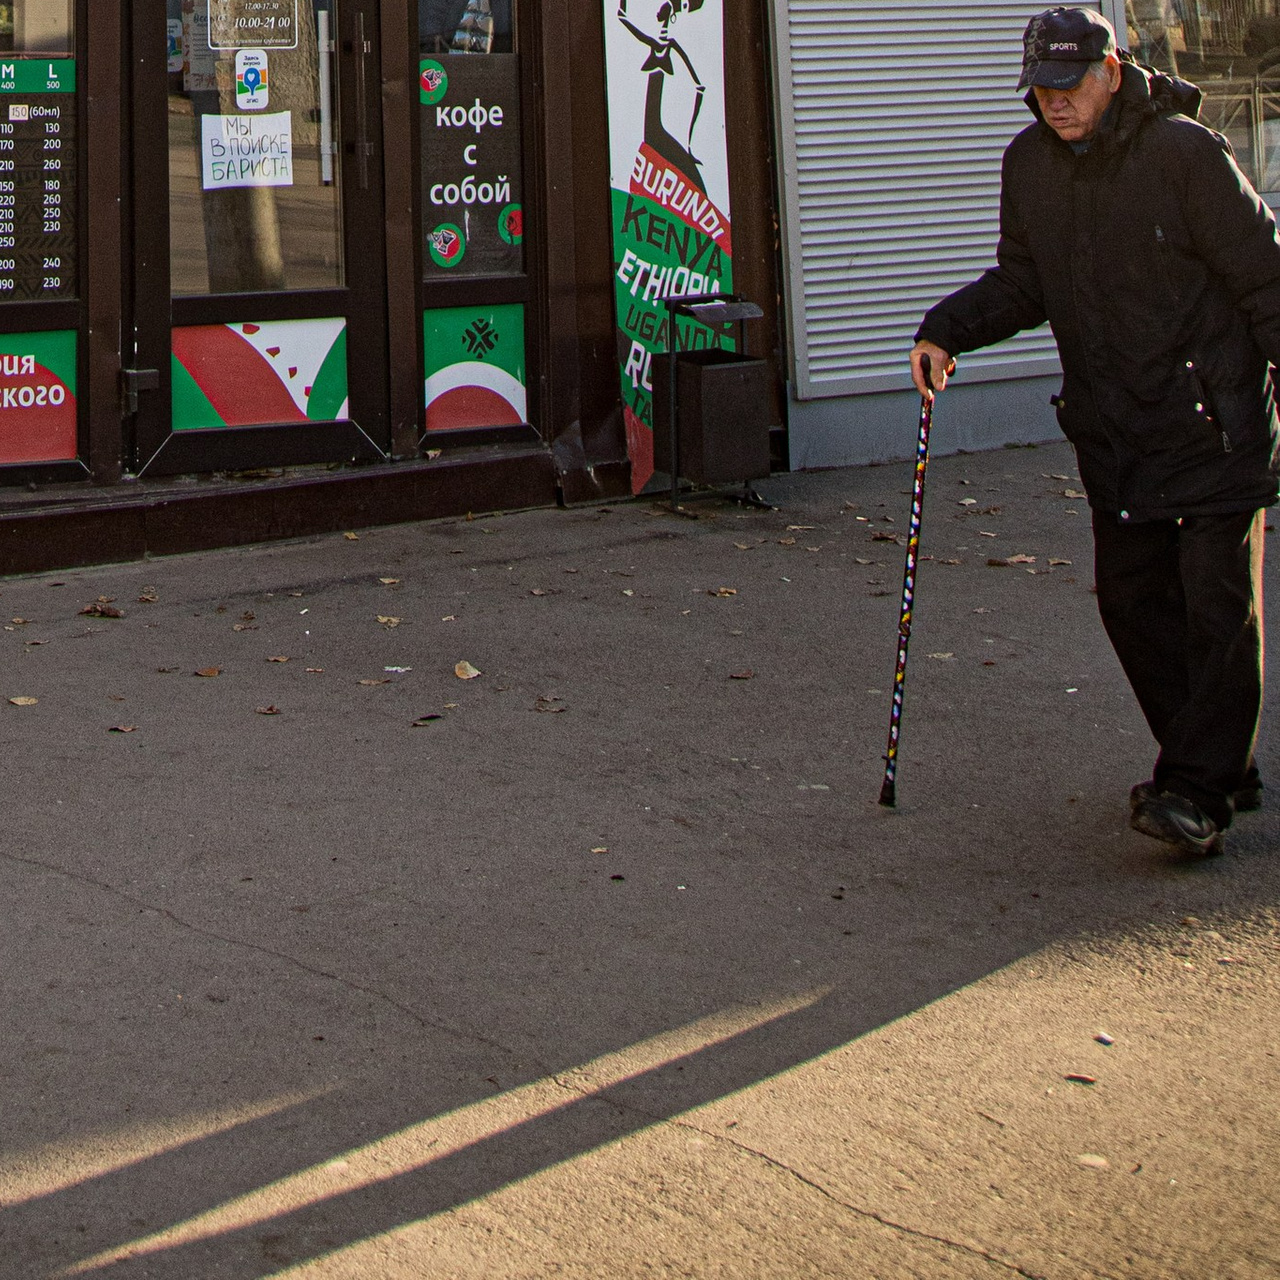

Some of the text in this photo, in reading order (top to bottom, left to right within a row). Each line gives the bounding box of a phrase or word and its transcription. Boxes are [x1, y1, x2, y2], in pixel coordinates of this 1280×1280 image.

[1049, 43, 1078, 51] SPORTS
[2, 64, 14, 79] M
[49, 64, 58, 78] L
[1, 81, 15, 90] 400
[46, 81, 60, 89] 500
[29, 106, 60, 118] (60мл)
[436, 98, 504, 133] кофе
[0, 124, 14, 133] 110
[45, 123, 60, 133] 130
[226, 116, 252, 136] МЫ
[0, 140, 14, 150] 170
[43, 139, 61, 149] 200
[210, 133, 289, 157] В ПОИСКЕ
[463, 144, 477, 165] с
[0, 160, 14, 170] 210
[43, 160, 61, 170] 260
[211, 155, 289, 181] БАРИСТА
[0, 181, 14, 191] 150
[44, 180, 60, 190] 180
[429, 175, 511, 205] собой
[43, 194, 61, 205] 260
[632, 159, 725, 240] BURUNDI
[43, 208, 61, 218] 250
[43, 221, 61, 231] 230
[620, 194, 723, 278] KENYA
[43, 258, 61, 268] 240
[43, 278, 60, 288] 230
